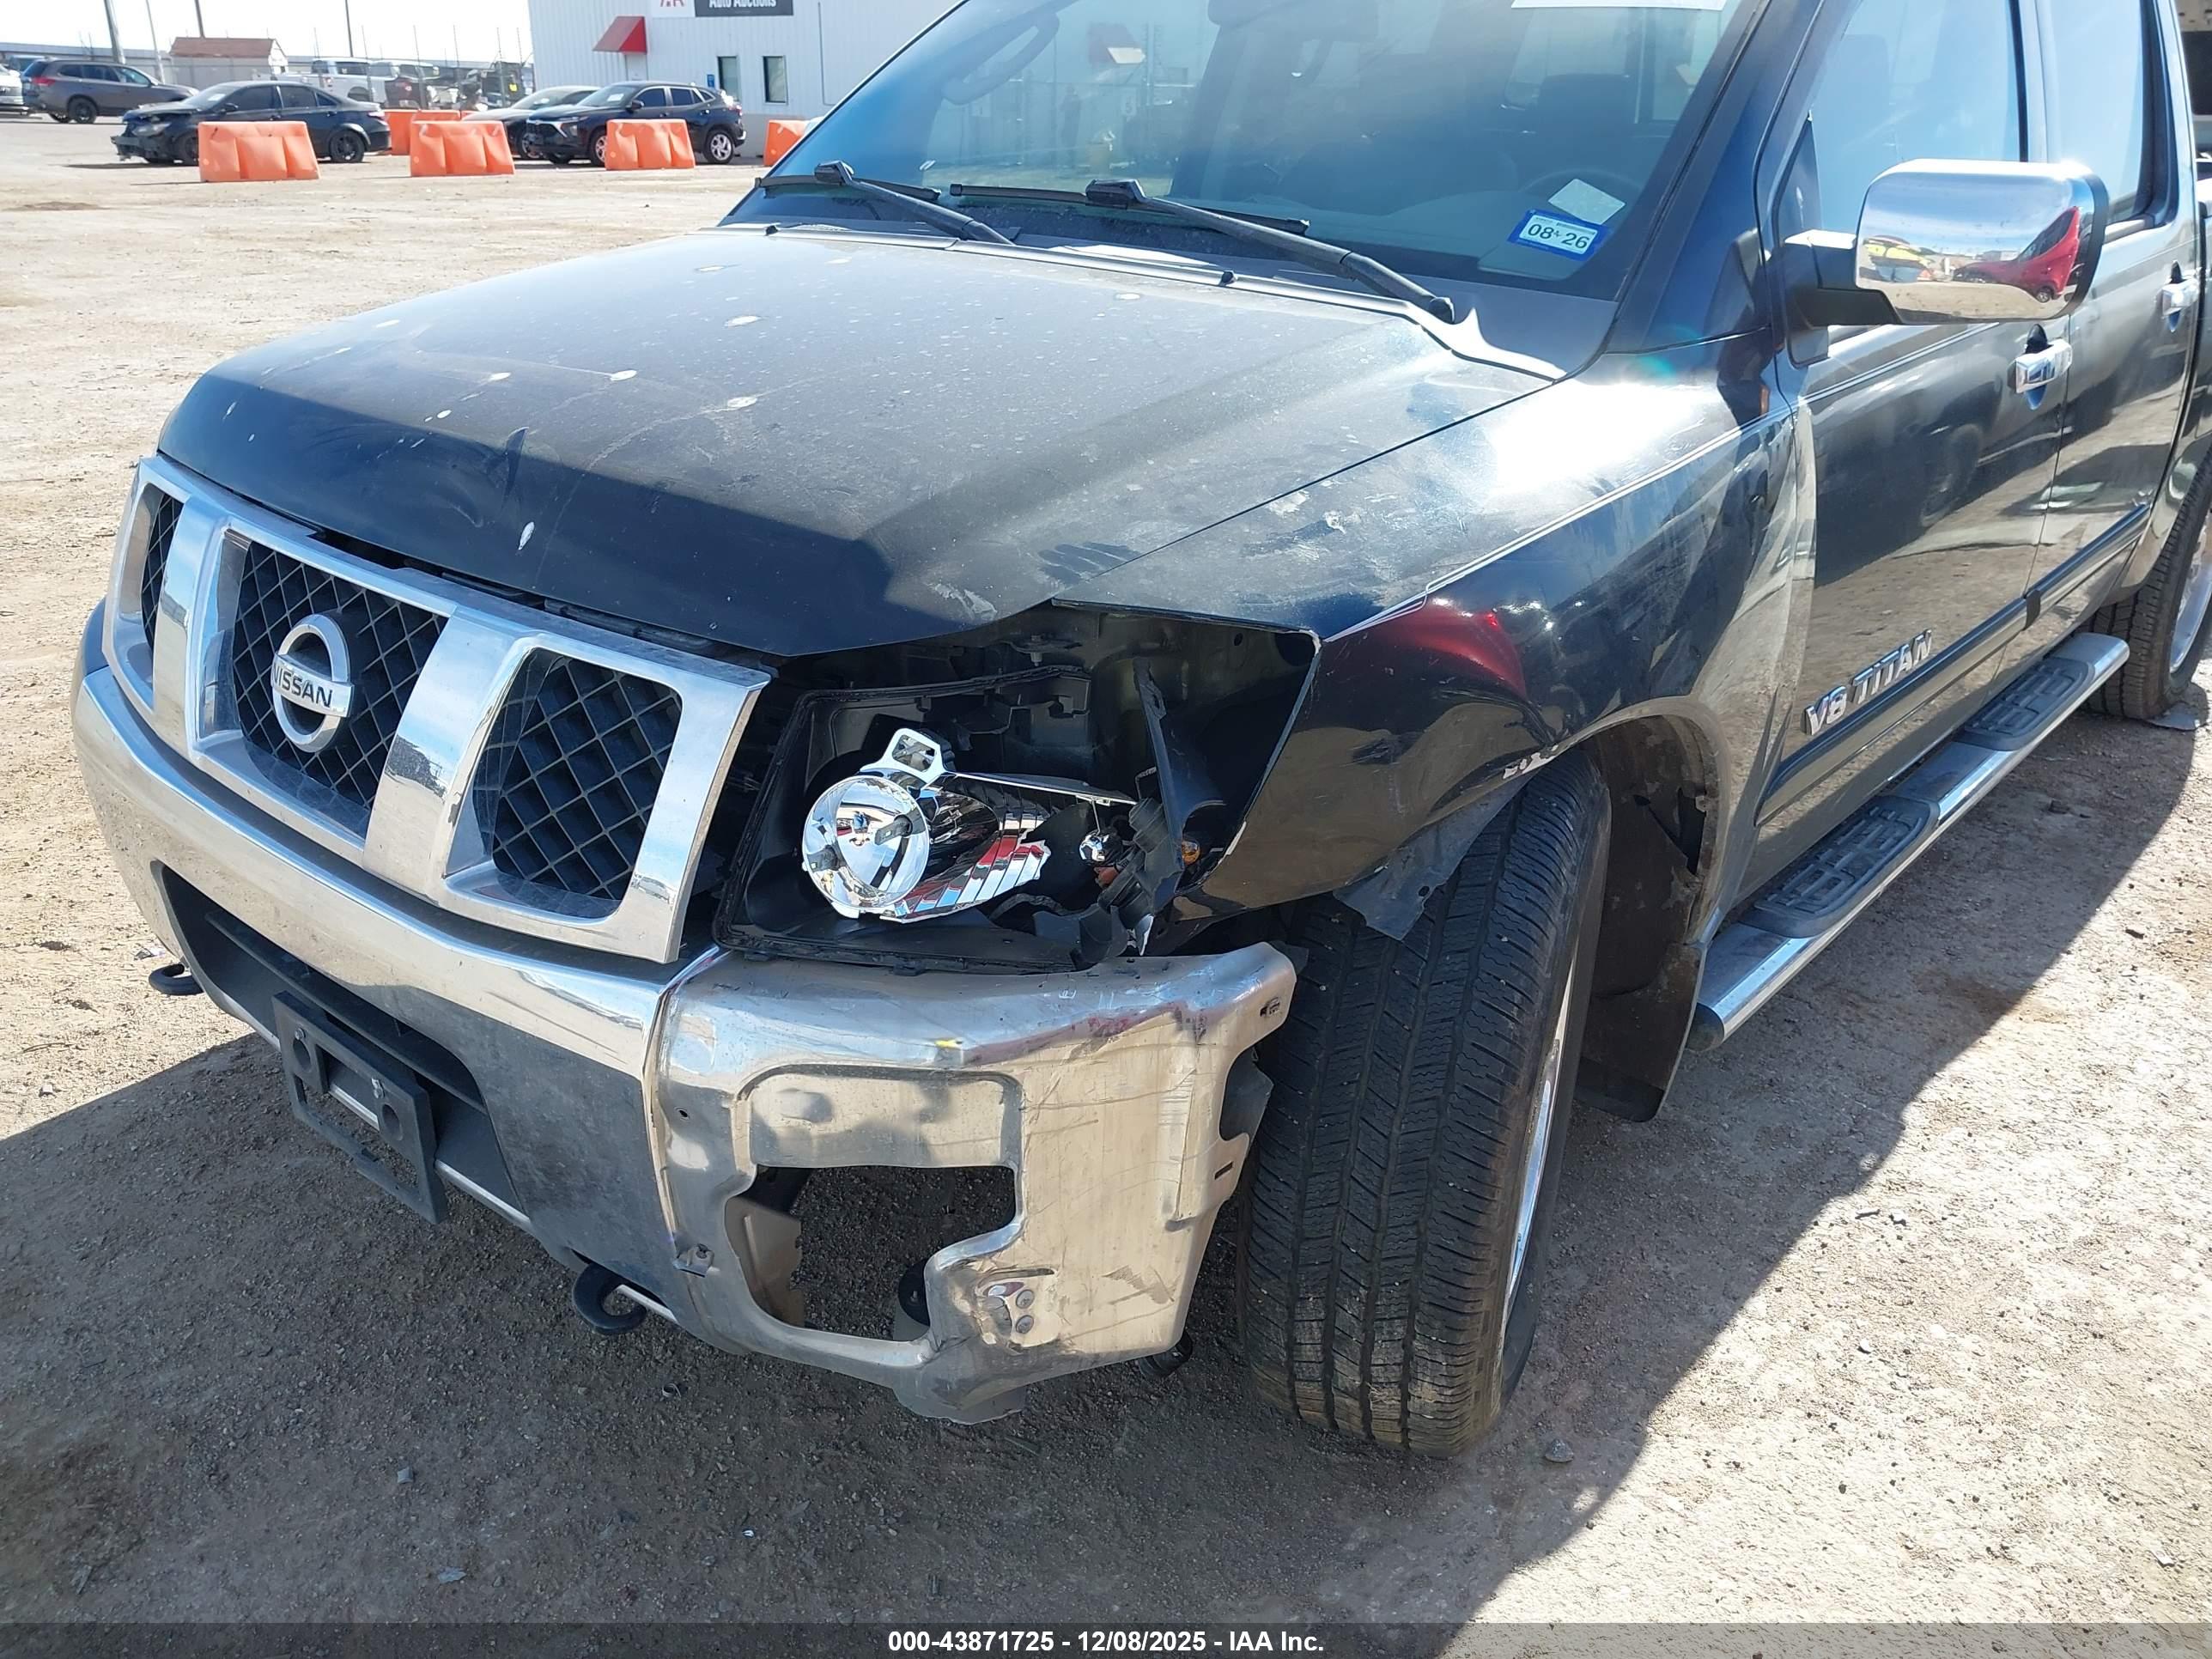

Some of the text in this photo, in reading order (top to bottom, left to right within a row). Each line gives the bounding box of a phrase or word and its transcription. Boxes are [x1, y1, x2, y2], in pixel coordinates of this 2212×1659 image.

[1528, 223, 1554, 240] 08
[1561, 232, 1590, 249] 26
[271, 661, 333, 708] NISSAN
[1804, 628, 1932, 737] V8 TITAN
